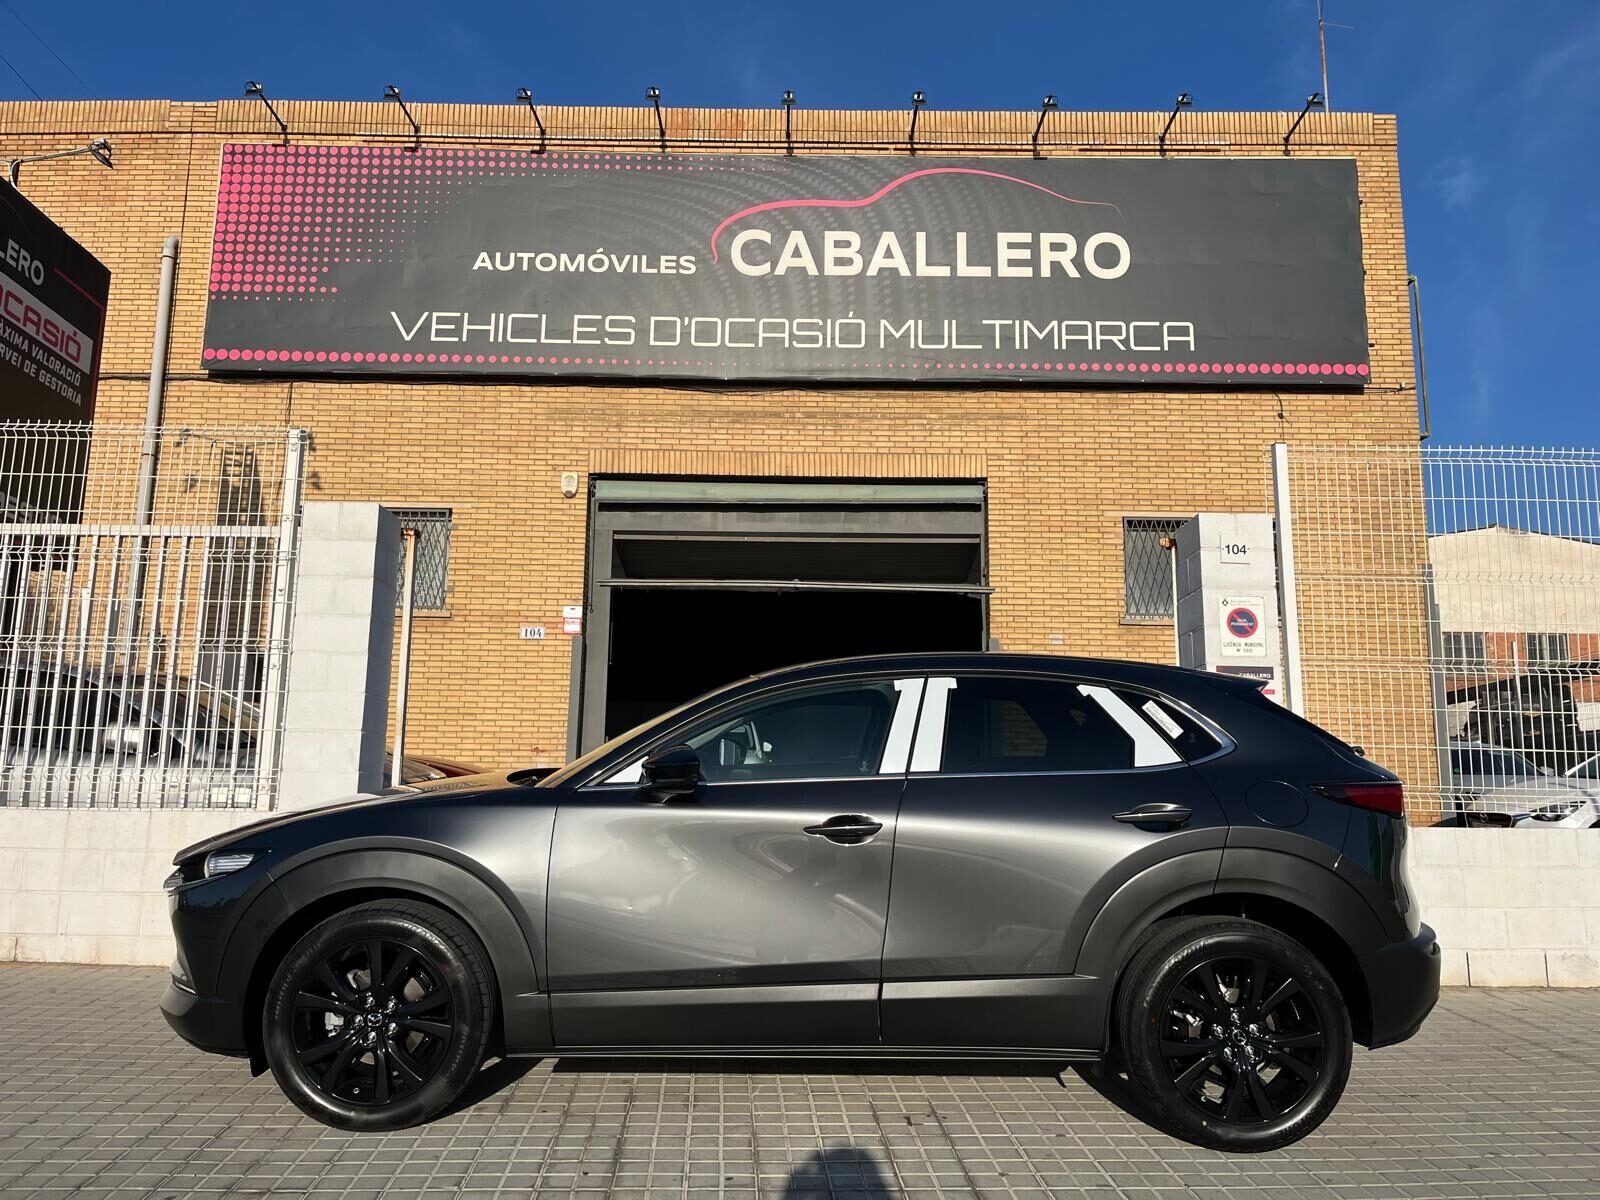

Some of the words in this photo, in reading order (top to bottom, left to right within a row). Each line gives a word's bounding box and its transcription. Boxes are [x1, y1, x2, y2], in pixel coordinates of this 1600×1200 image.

[0, 238, 45, 286] ERO
[472, 247, 697, 276] AUTOMÓVILES
[730, 228, 1132, 280] CABALLERO
[0, 284, 82, 364] CASIÓ
[390, 310, 636, 346] VEHICLES
[649, 311, 866, 350] D'OCASIÓ
[879, 319, 1196, 352] MULTIMARCA
[23, 359, 38, 378] DE
[38, 369, 82, 407] GESTORIA
[32, 343, 81, 387] VALORACIÓ
[1224, 544, 1248, 555] 104
[524, 628, 542, 638] 104
